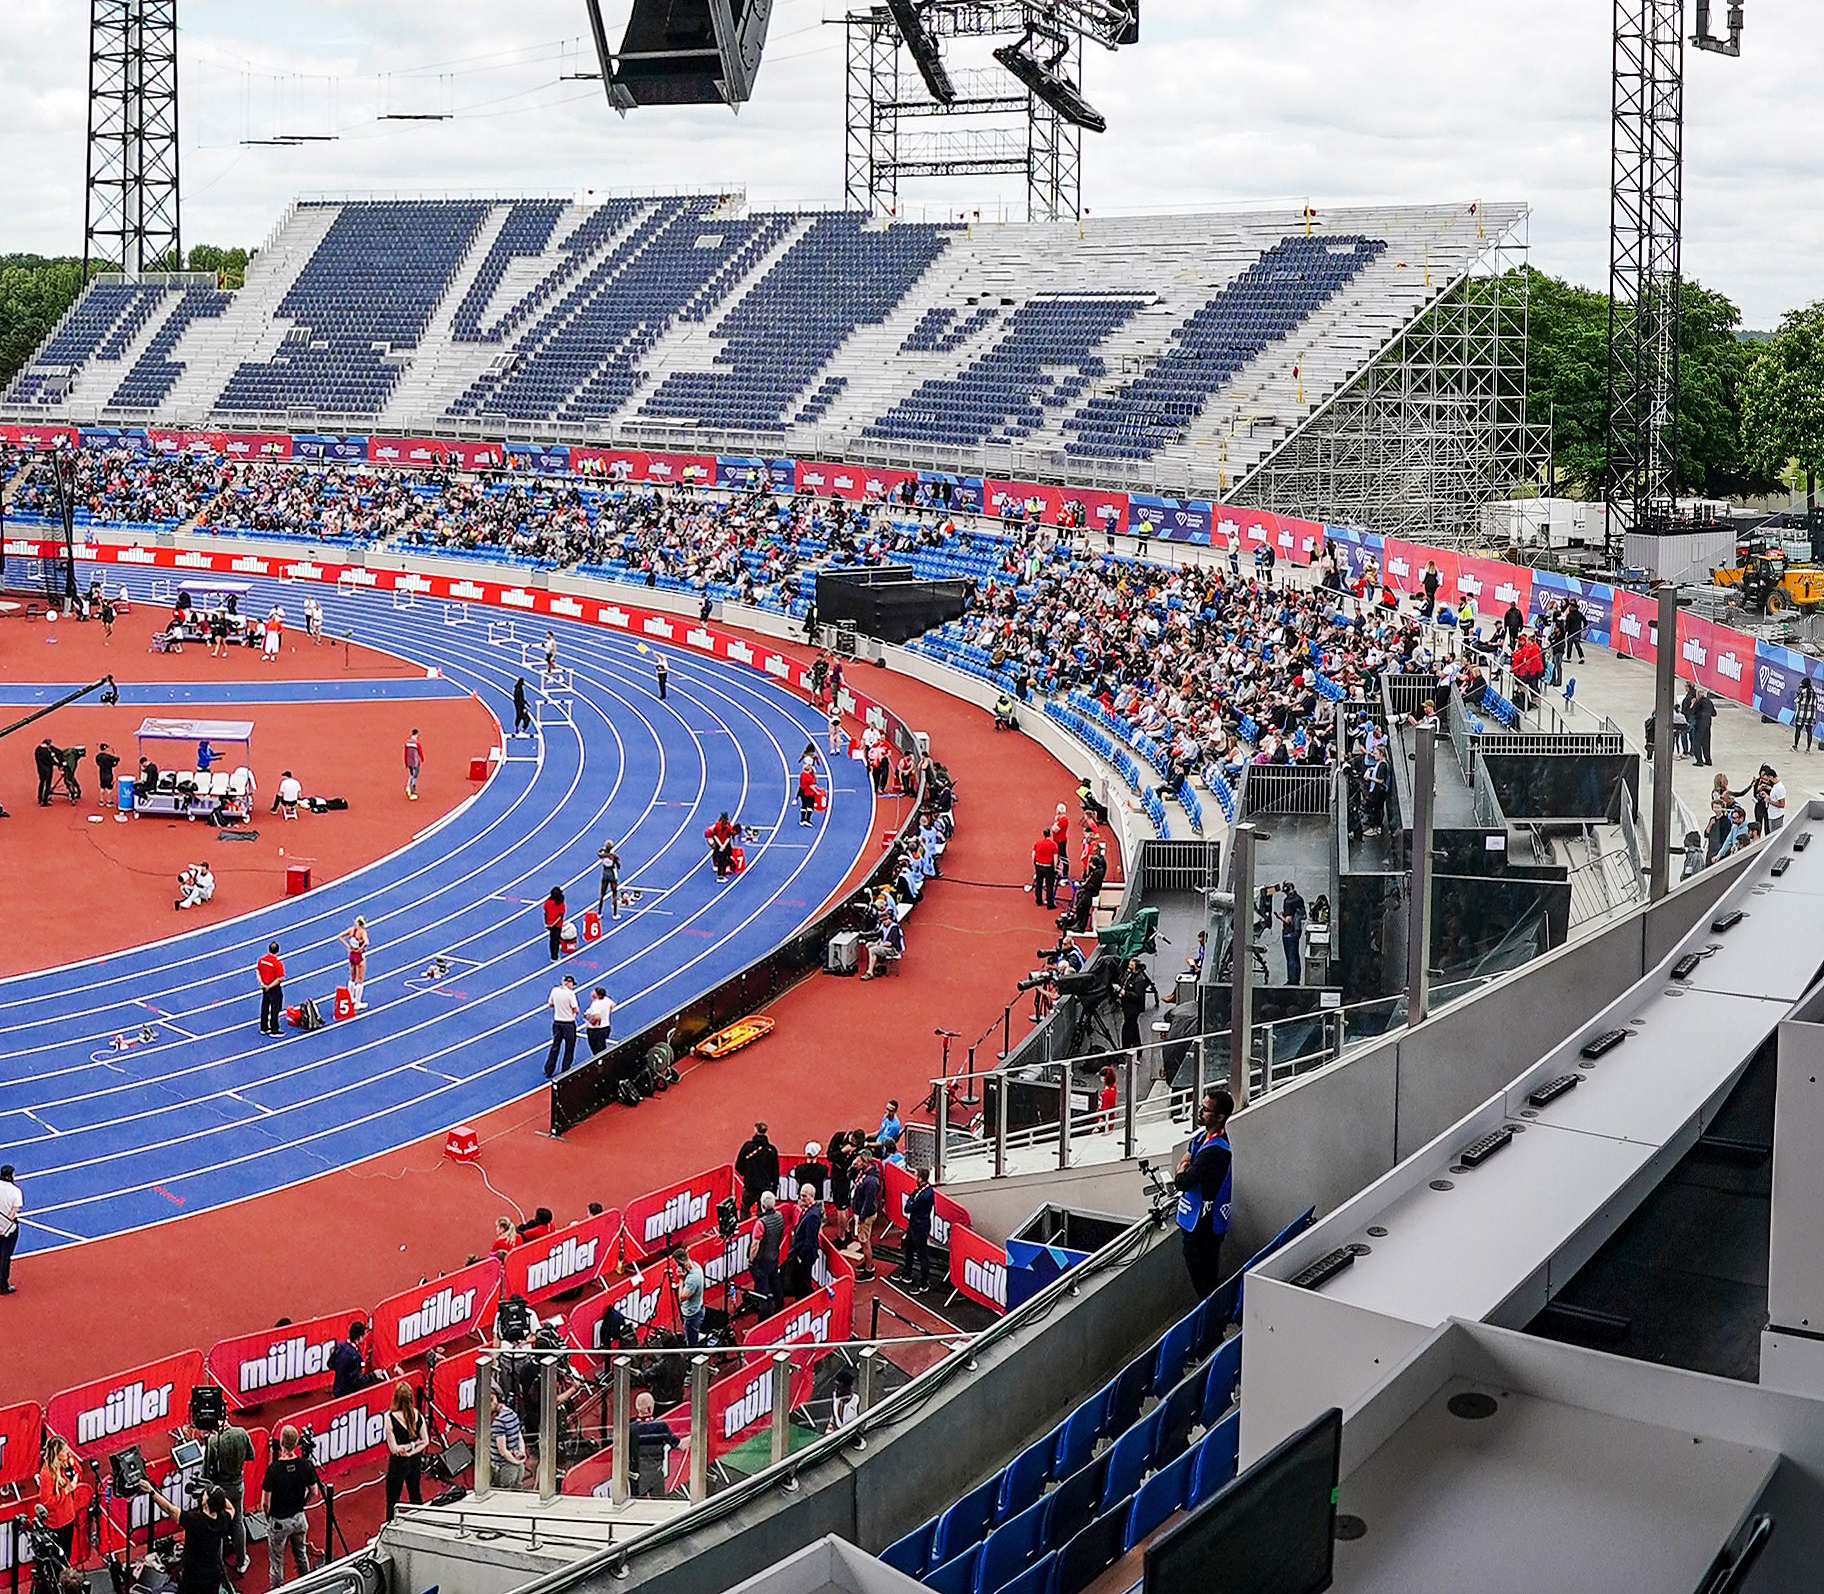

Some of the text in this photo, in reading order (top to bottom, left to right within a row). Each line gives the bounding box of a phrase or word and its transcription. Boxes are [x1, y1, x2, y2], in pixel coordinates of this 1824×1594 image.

[117, 547, 156, 564] müller
[175, 552, 212, 568] müller
[232, 557, 269, 573] müller
[287, 562, 323, 579] müller
[340, 568, 377, 585] müller
[395, 574, 432, 592] müller
[449, 581, 485, 599] müller
[1458, 573, 1483, 596] müller
[501, 589, 535, 608] müller
[1495, 582, 1520, 605] müller
[550, 597, 583, 617] müller
[599, 606, 630, 627] müller
[644, 617, 674, 638] müller
[1620, 614, 1642, 639] müller
[1683, 638, 1707, 667] müller
[1718, 651, 1742, 682] müller
[821, 796, 827, 808] 8
[737, 856, 744, 869] 7
[590, 922, 599, 937] 6
[339, 999, 350, 1015] 5
[644, 1190, 712, 1242] müller
[527, 1236, 598, 1294] müller
[964, 1257, 1007, 1307] müll
[397, 1287, 476, 1348] müller
[240, 1337, 337, 1393] müller
[77, 1381, 175, 1444] müller
